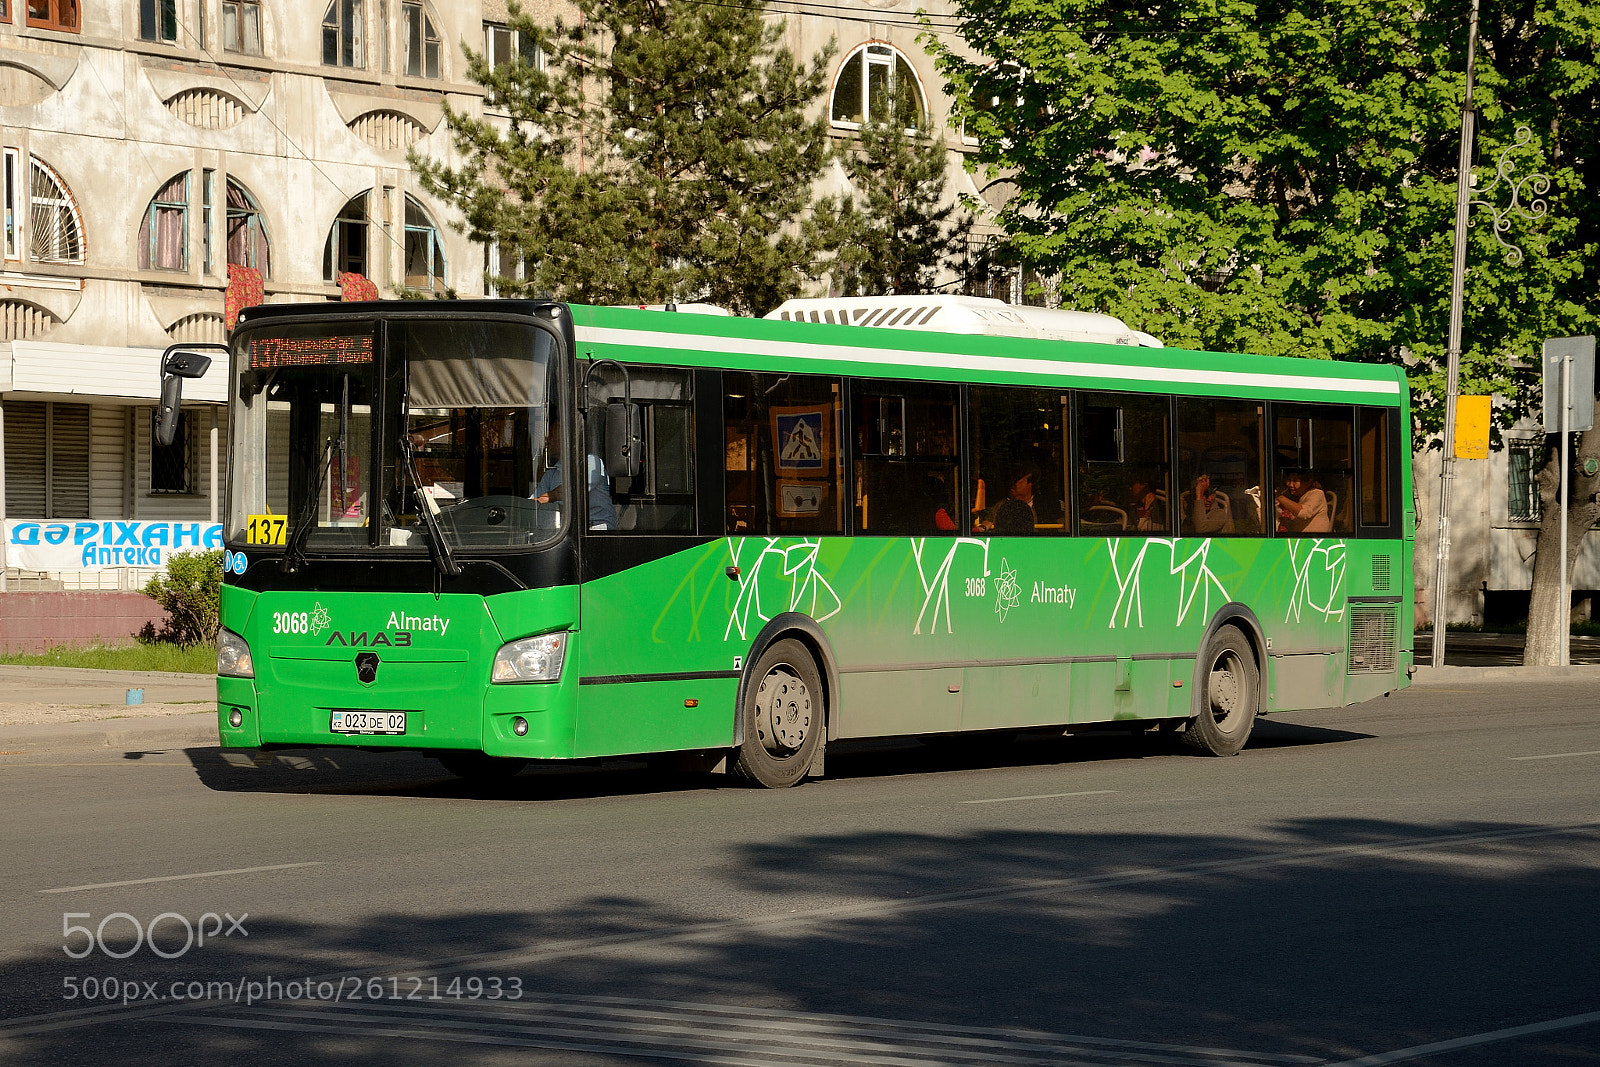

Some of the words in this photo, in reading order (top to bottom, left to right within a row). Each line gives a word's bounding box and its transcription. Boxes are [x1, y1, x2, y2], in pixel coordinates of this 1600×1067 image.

[249, 518, 285, 544] 137
[82, 542, 161, 567] Аптека
[965, 577, 986, 597] 3068
[1030, 580, 1077, 609] Almaty
[272, 611, 308, 634] 3068
[386, 610, 450, 636] Almaty
[325, 631, 412, 647] ЛИАЗ
[345, 713, 367, 728] 023
[369, 717, 384, 729] DE
[388, 714, 404, 729] 02
